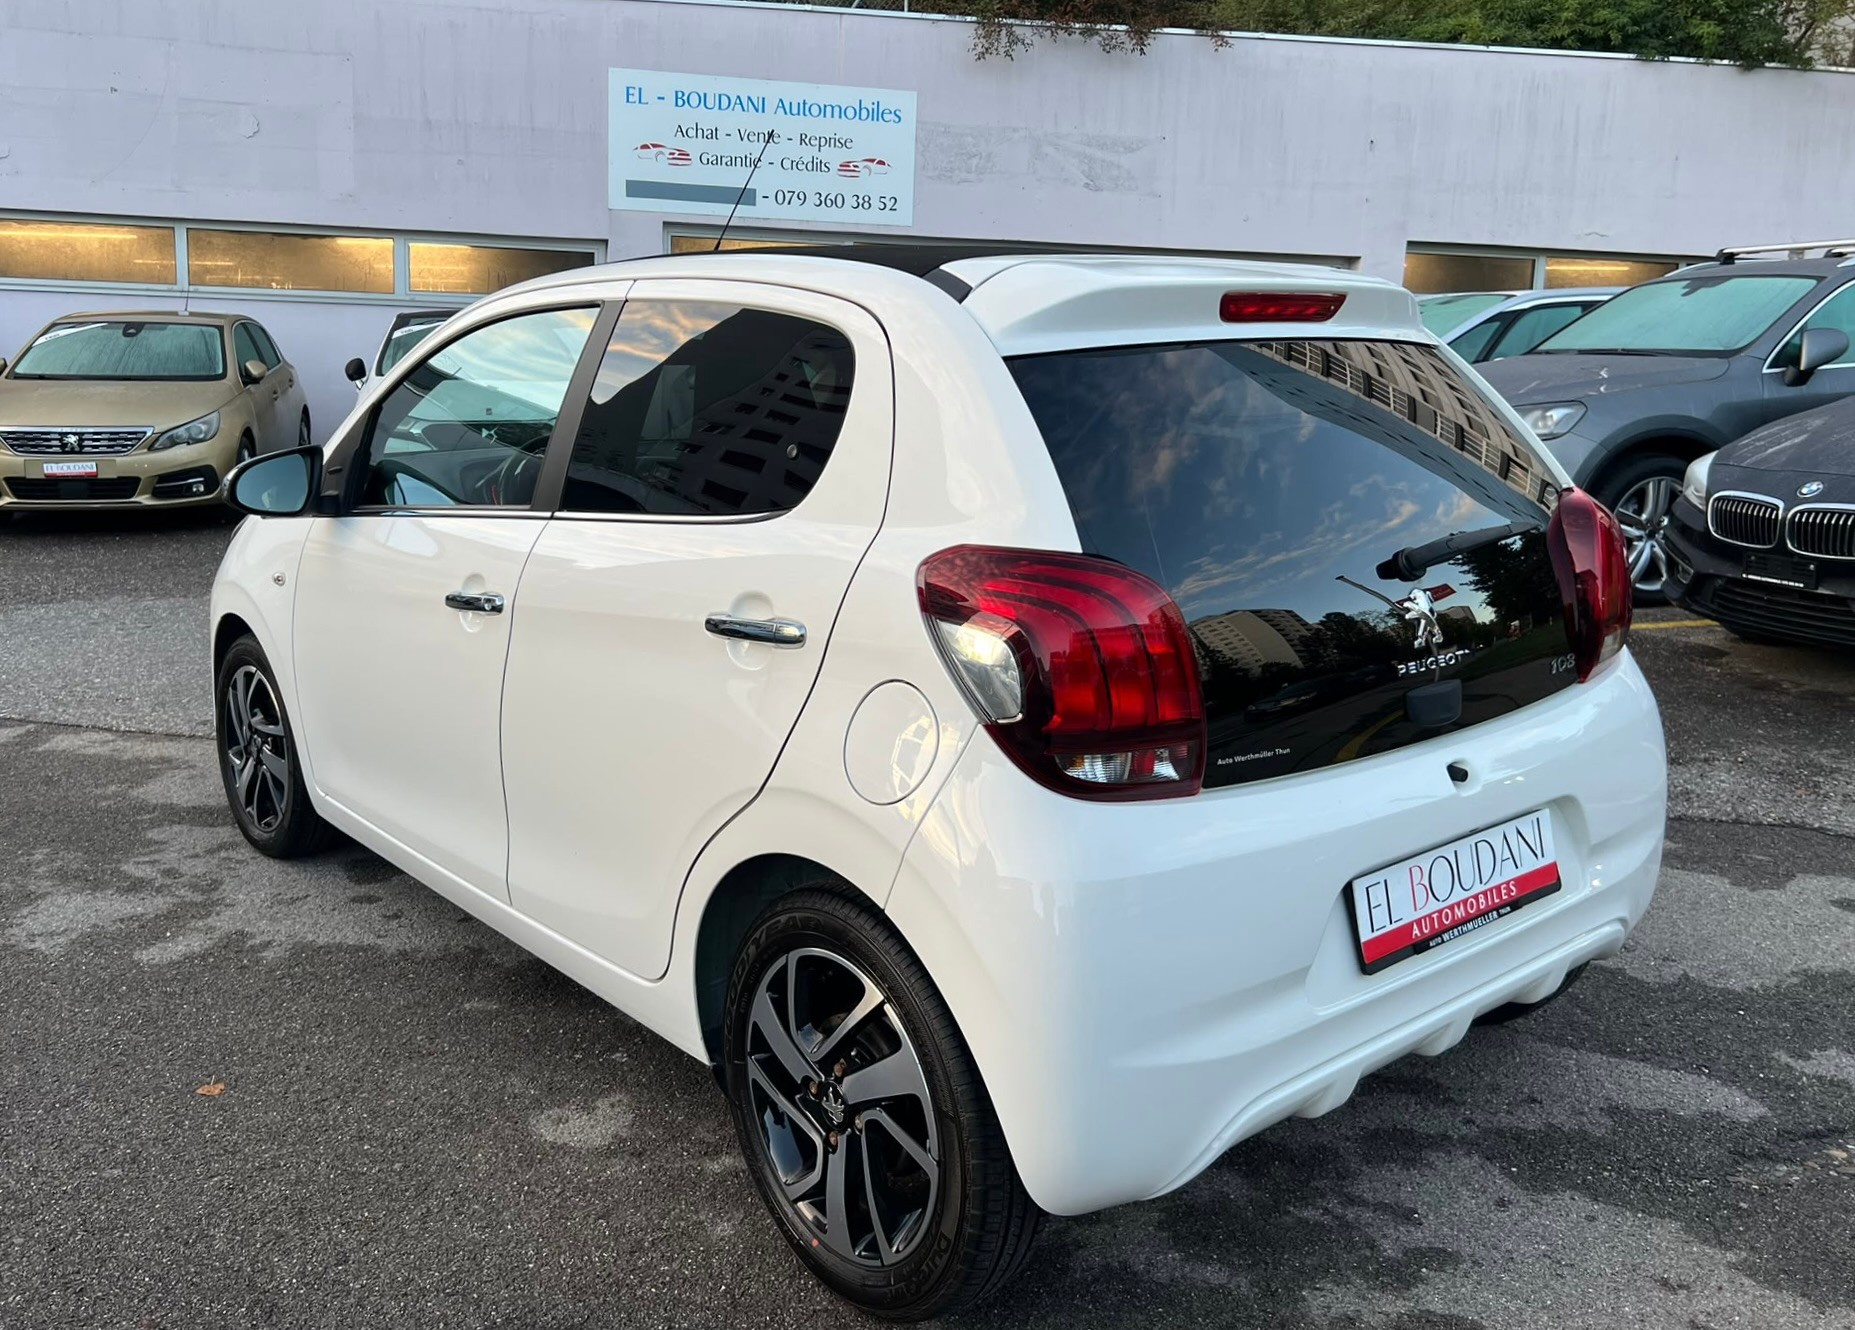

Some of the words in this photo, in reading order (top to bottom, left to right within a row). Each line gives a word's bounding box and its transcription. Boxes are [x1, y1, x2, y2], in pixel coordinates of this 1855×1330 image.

[624, 86, 649, 105] EL
[674, 90, 766, 114] BOUDANI
[774, 97, 902, 124] Automobiles
[674, 121, 719, 141] Achat
[737, 128, 781, 145] Vente
[799, 132, 854, 153] Reprise
[699, 151, 762, 169] Garantie
[780, 155, 831, 173] Crédits
[774, 189, 807, 206] 079
[813, 191, 846, 209] 360
[850, 194, 872, 211] 38
[878, 196, 898, 212] 52
[1397, 649, 1466, 677] PEUGEOT
[1551, 652, 1576, 675] 108
[1364, 878, 1403, 933] EL
[1408, 817, 1546, 912] BOUDANI
[1411, 880, 1518, 939] AUTOMOBILES
[1442, 911, 1499, 942] WERTHMUELLER
